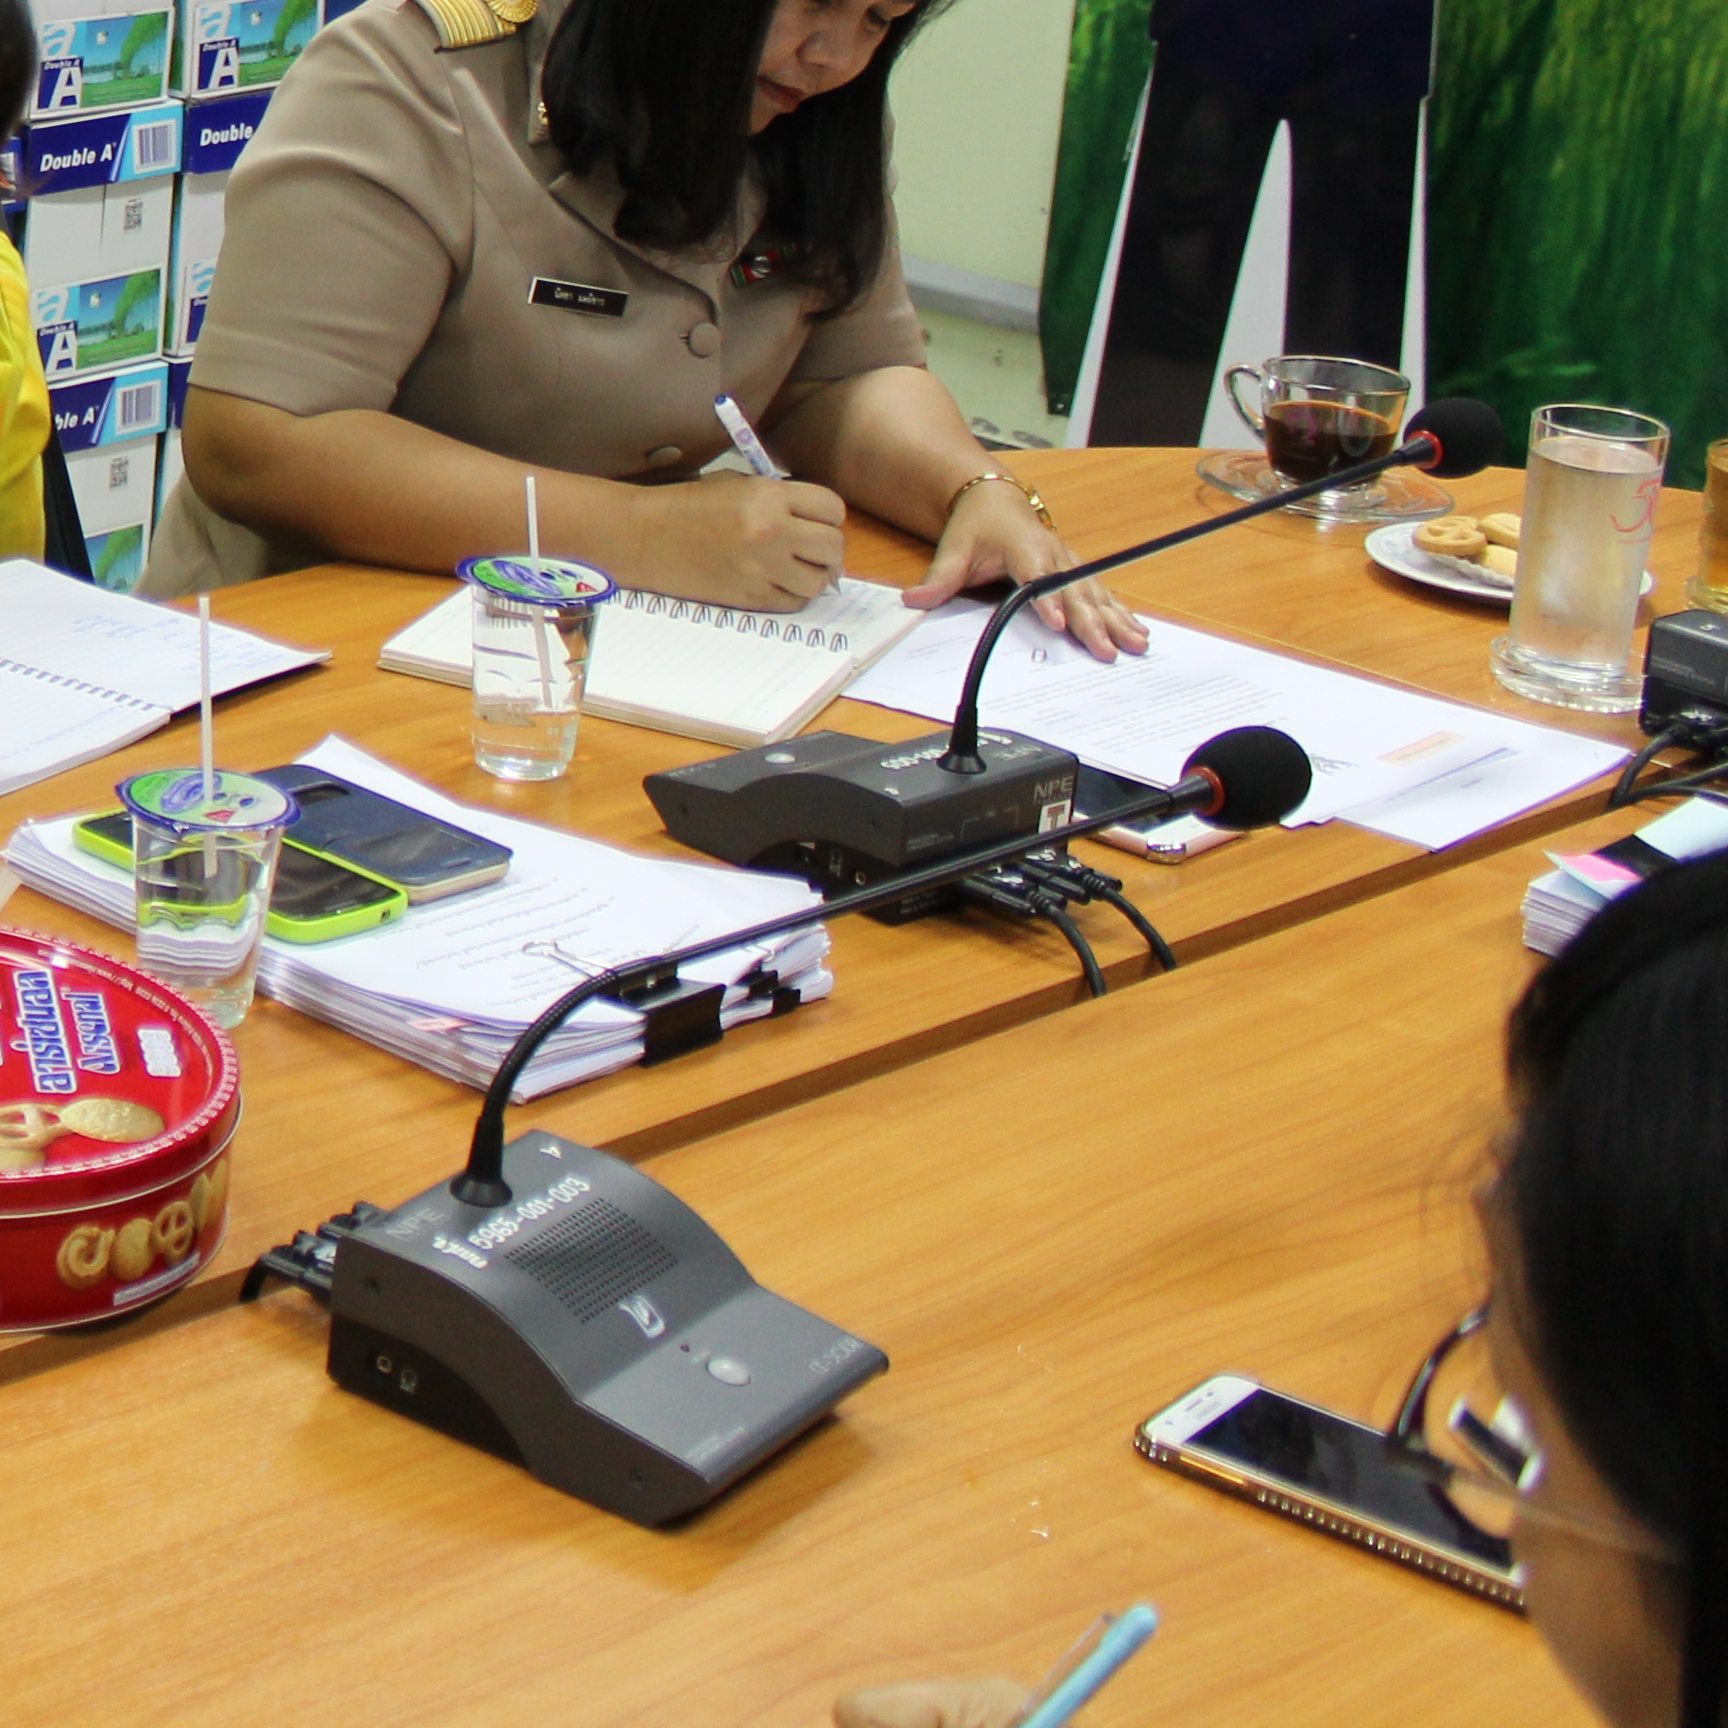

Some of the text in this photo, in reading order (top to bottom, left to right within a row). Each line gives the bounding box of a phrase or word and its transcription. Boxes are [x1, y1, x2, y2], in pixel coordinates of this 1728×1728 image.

[40, 144, 114, 173] Double A
[199, 124, 253, 147] Double
[1033, 774, 1075, 799] NPE
[11, 968, 79, 1095] อาร์เซนอล
[63, 992, 121, 1076] Arsenal
[466, 1175, 593, 1251] 5965-001-003
